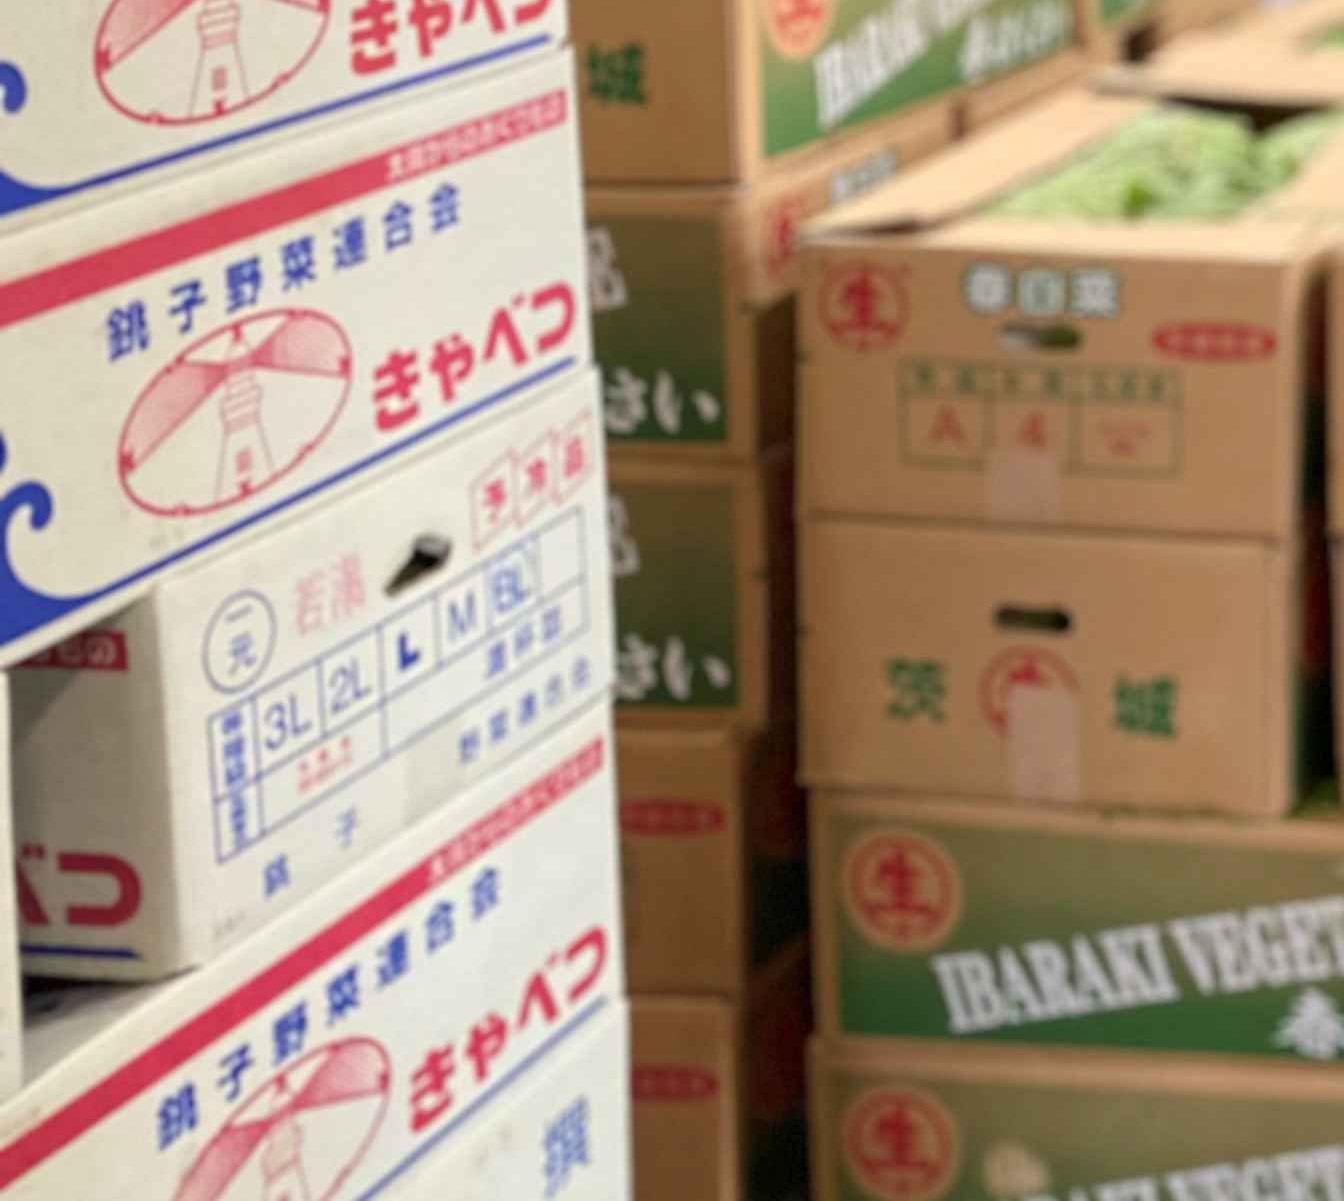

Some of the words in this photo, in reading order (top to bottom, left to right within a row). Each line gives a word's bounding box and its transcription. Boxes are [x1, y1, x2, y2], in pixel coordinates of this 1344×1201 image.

[107, 183, 461, 362] 銚子野菜連合会
[372, 281, 578, 433] きゃべつ
[264, 692, 312, 751] 3L
[329, 655, 371, 715] 2L
[398, 631, 421, 671] L
[409, 925, 608, 1135] きゃべつ
[931, 921, 1183, 1036] IBARAKI
